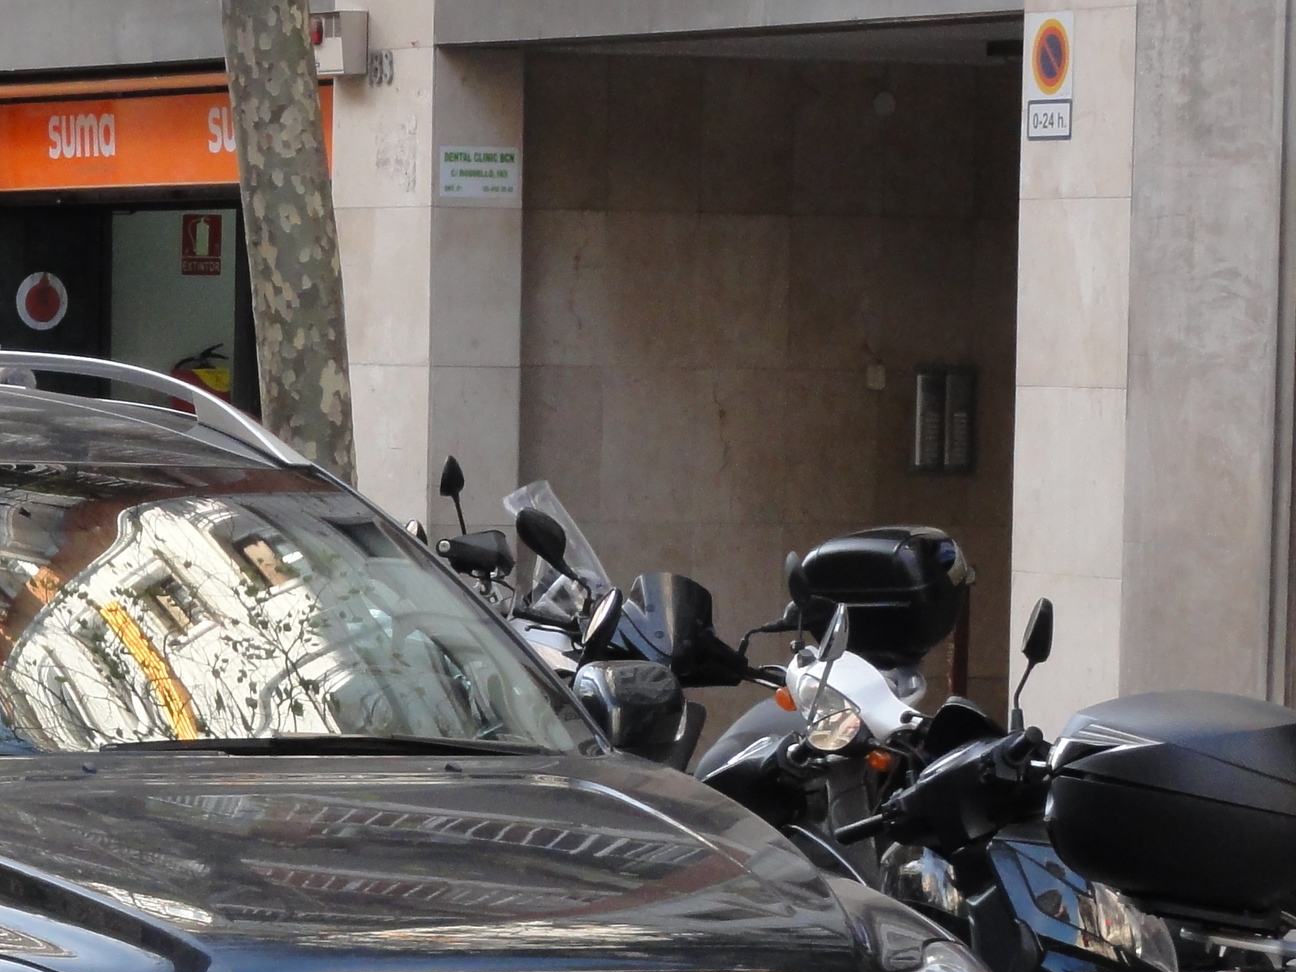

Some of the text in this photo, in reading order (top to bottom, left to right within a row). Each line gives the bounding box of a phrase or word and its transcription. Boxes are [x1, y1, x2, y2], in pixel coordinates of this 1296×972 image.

[48, 112, 116, 160] suma
[207, 105, 237, 154] su
[1032, 112, 1054, 129] 0-24
[182, 260, 220, 272] EXTINTOR
